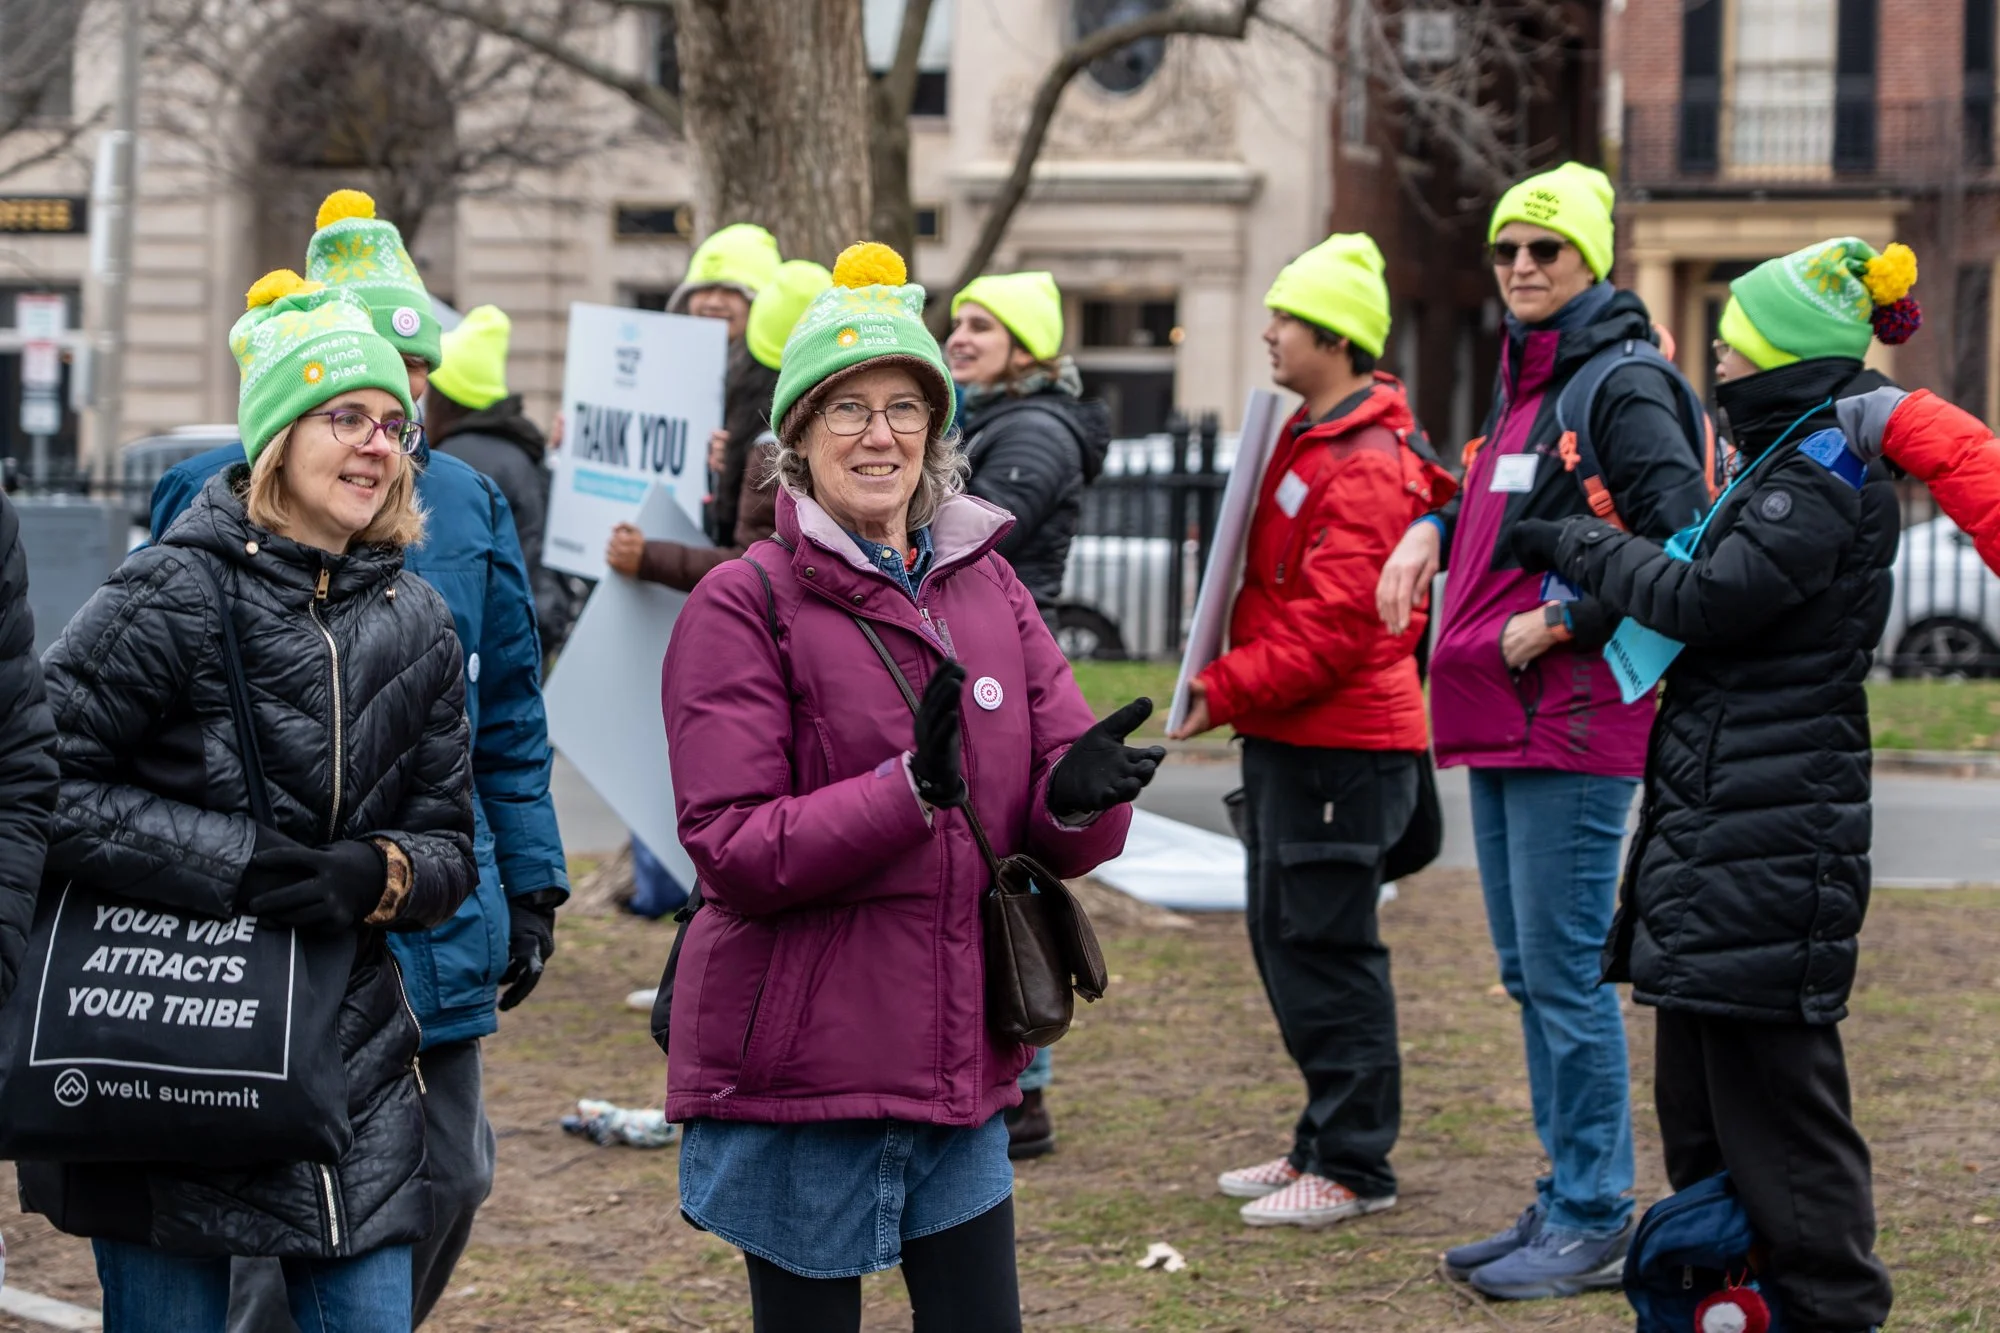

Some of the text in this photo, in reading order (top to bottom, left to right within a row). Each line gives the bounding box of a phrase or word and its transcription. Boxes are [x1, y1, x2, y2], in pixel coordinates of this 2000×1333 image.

[0, 199, 72, 229] FFEE
[860, 323, 895, 334] lunch
[863, 335, 898, 347] place
[298, 334, 359, 359] women's
[324, 347, 364, 365] lunch
[330, 362, 367, 384] place
[571, 402, 688, 476] THANK YOU
[91, 620, 122, 660] KORS
[93, 905, 258, 945] YOUR VIBE
[82, 946, 247, 984] ATTRACTS
[67, 987, 260, 1028] YOUR TRIBE
[96, 1080, 260, 1109] well summit
